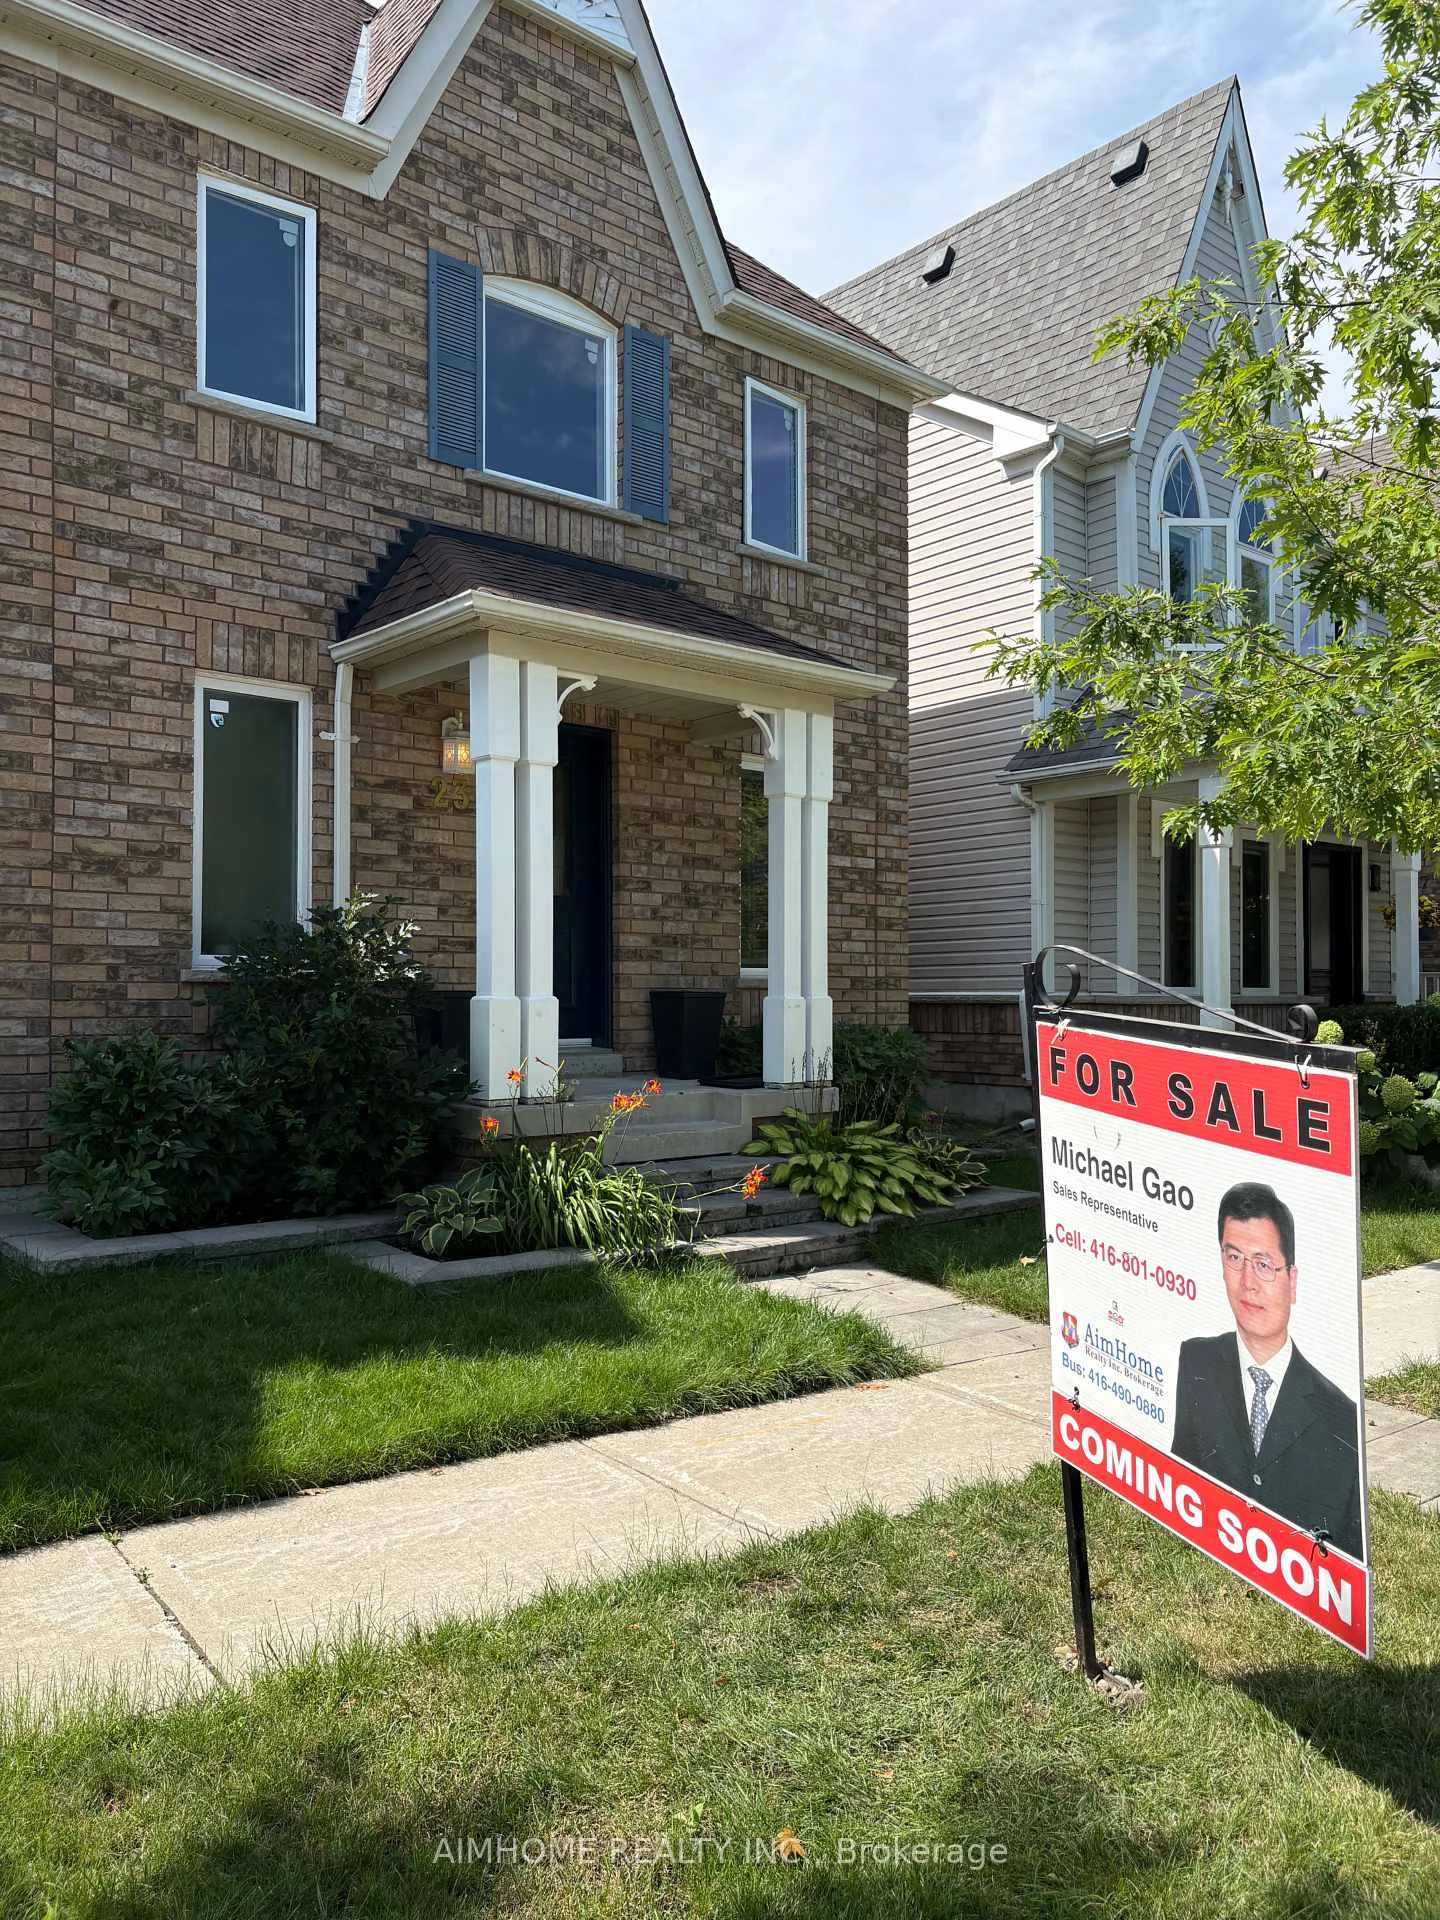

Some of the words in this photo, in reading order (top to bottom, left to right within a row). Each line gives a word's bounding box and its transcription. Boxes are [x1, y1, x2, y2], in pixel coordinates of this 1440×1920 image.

[1050, 1046, 1137, 1107] FOR
[1167, 1072, 1331, 1153] SALE
[1052, 1136, 1133, 1191] Michael
[1142, 1166, 1194, 1211] Gao
[1053, 1180, 1078, 1202] Sales
[1081, 1191, 1159, 1232] Representative
[1055, 1223, 1086, 1253] Cell:
[1090, 1239, 1197, 1301] 416-801-0930
[1062, 1352, 1086, 1378] Bus:
[1088, 1368, 1165, 1424] 416-490-0880
[1084, 1323, 1164, 1382] AimHome
[1085, 1344, 1107, 1367] Realty
[1124, 1367, 1164, 1397] Brokerage
[1059, 1413, 1203, 1528] COMING
[1217, 1508, 1352, 1627] SOON
